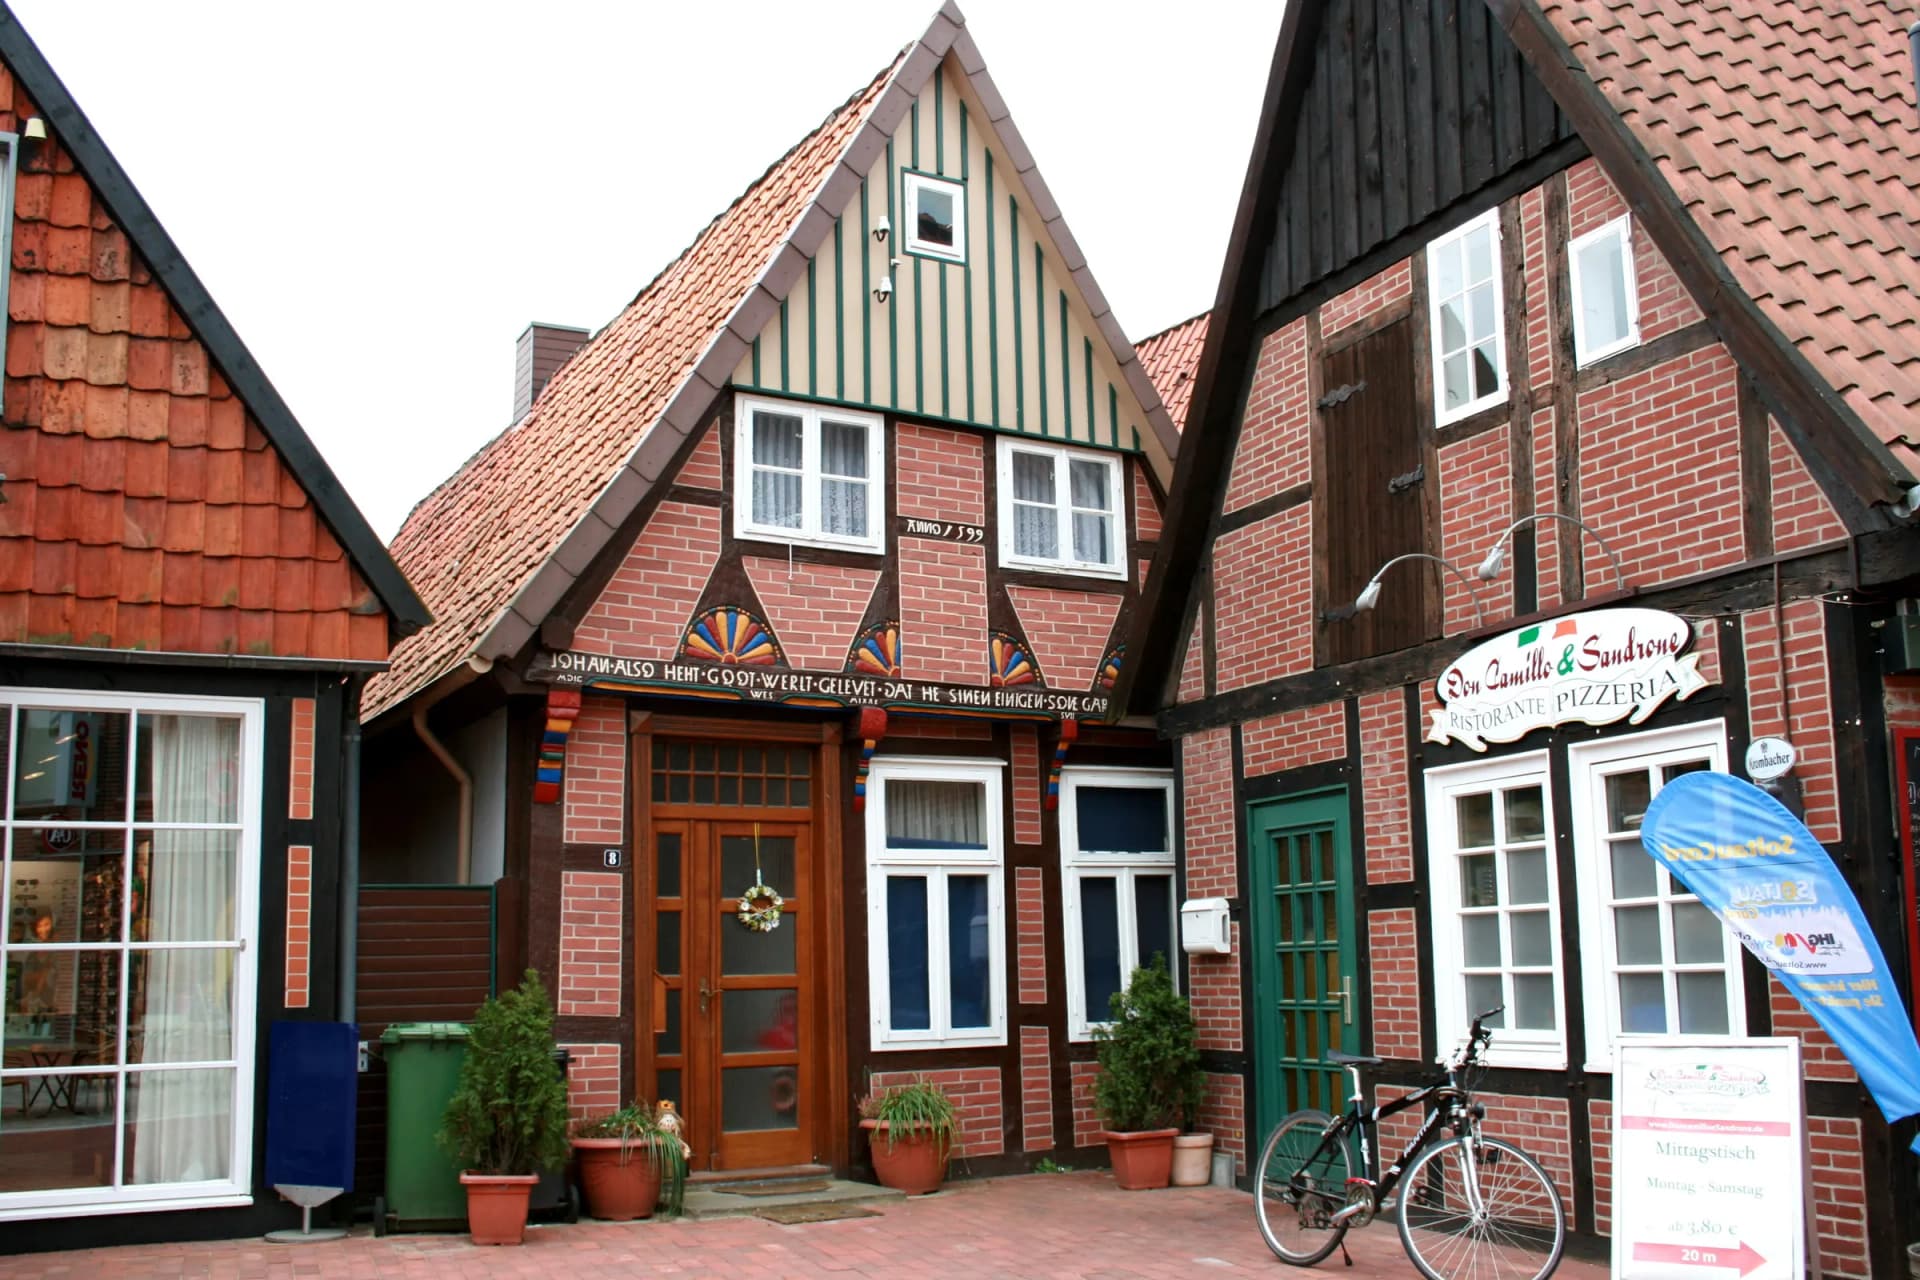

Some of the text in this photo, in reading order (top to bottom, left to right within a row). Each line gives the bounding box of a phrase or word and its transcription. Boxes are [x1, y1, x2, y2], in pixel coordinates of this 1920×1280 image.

[907, 519, 941, 535] ANNO
[1447, 626, 1677, 699] Don Camillo & Sandrone
[922, 686, 939, 702] HE
[1450, 669, 1676, 731] RISTORANTE PIZZERIA
[608, 852, 617, 865] 8
[1656, 1140, 1756, 1163] Mittagstisch
[1647, 1176, 1696, 1193] Montag
[1707, 1181, 1763, 1199] Samstag
[1681, 1248, 1717, 1263] 20 m
